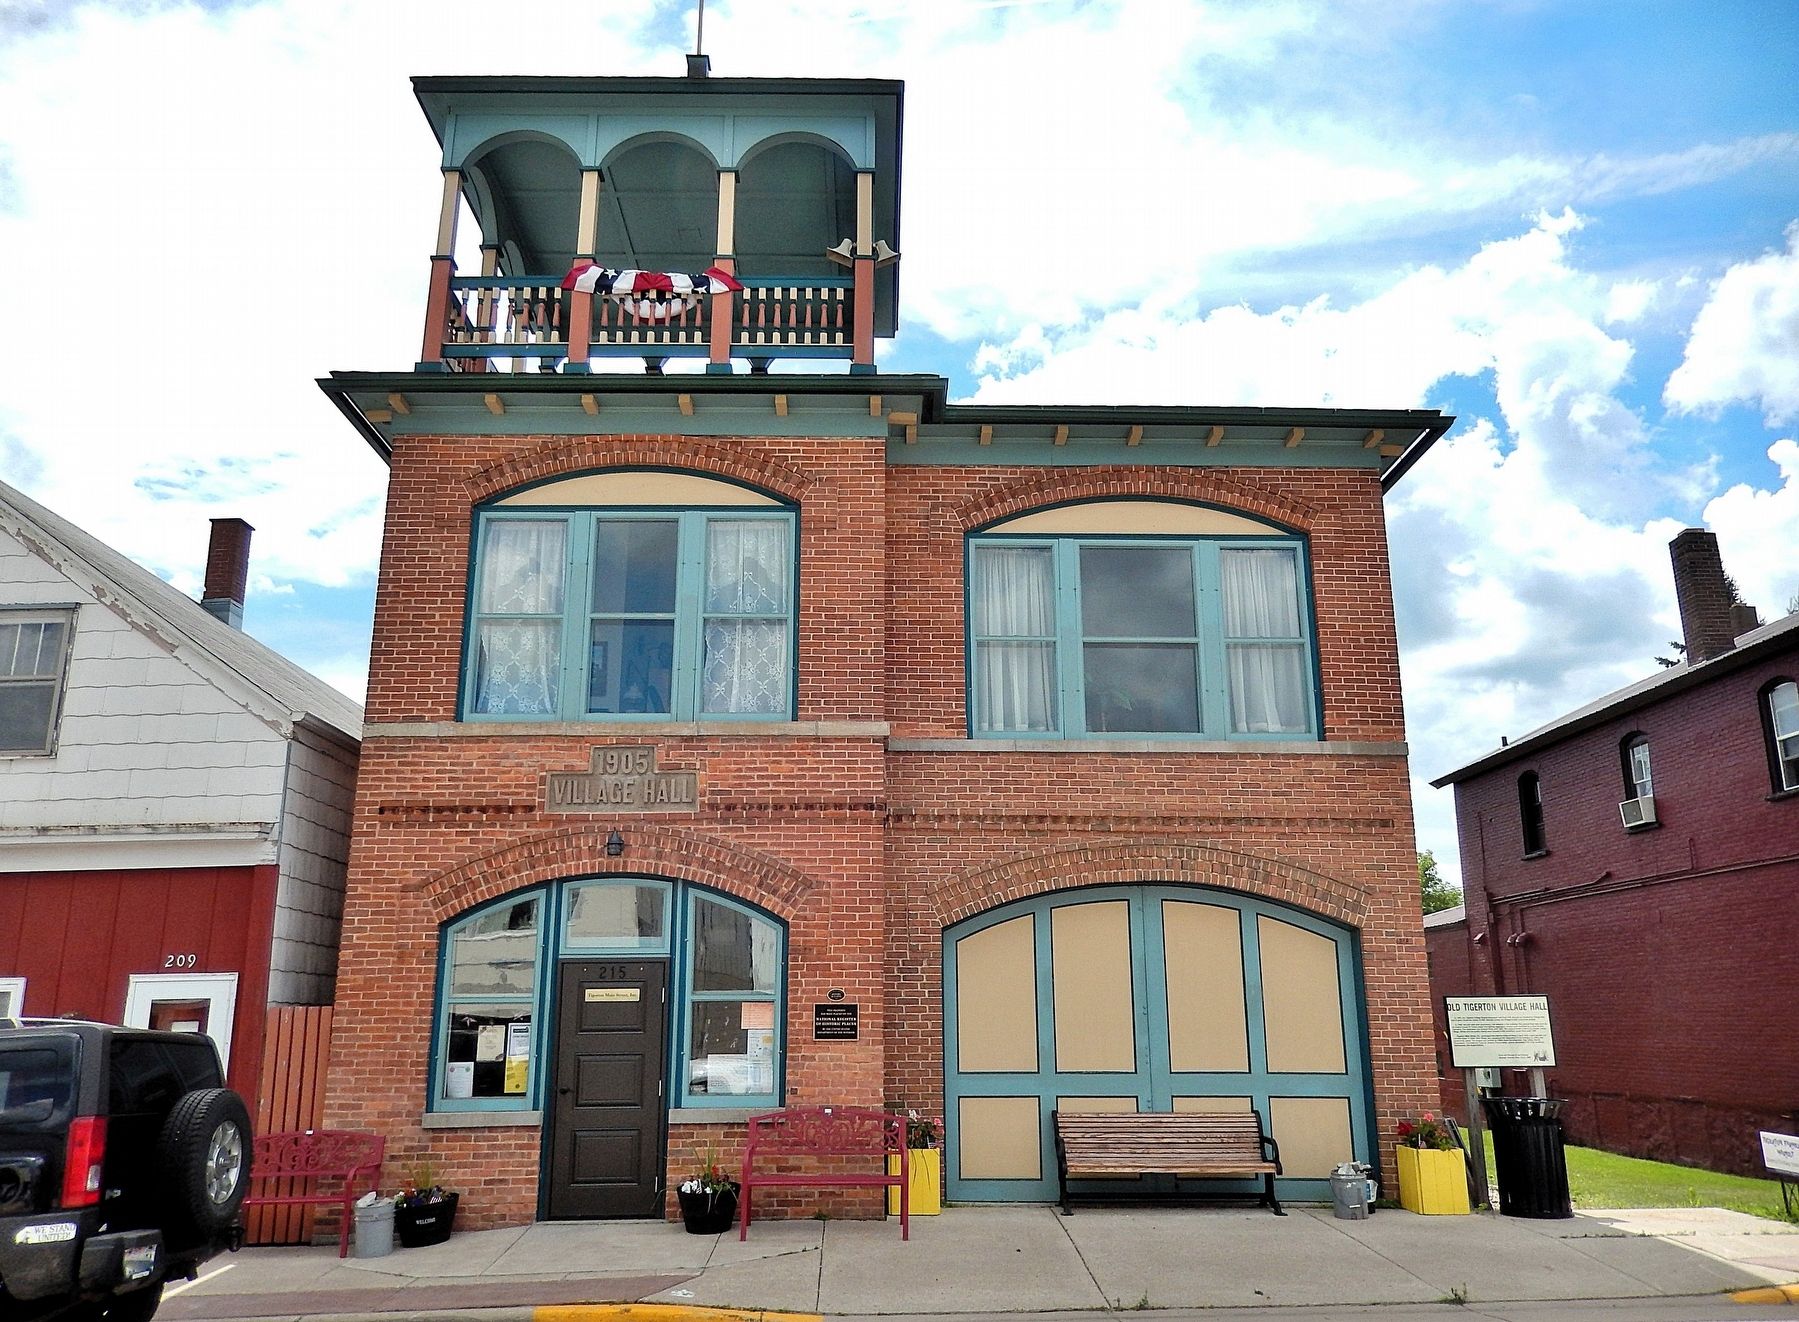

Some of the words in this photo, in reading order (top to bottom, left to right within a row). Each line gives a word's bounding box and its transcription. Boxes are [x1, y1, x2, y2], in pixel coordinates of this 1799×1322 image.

[598, 750, 649, 775] 1905
[553, 779, 636, 804] VILLAGE
[643, 778, 693, 803] HALL
[164, 954, 197, 969] 209
[599, 965, 627, 979] 215
[1447, 1003, 1461, 1011] OLD
[1464, 1002, 1497, 1011] TIGERTON
[1499, 1002, 1527, 1011] VILLAGE
[1530, 1002, 1548, 1010] HALL
[34, 1226, 46, 1234] WE
[49, 1223, 76, 1233] STAND
